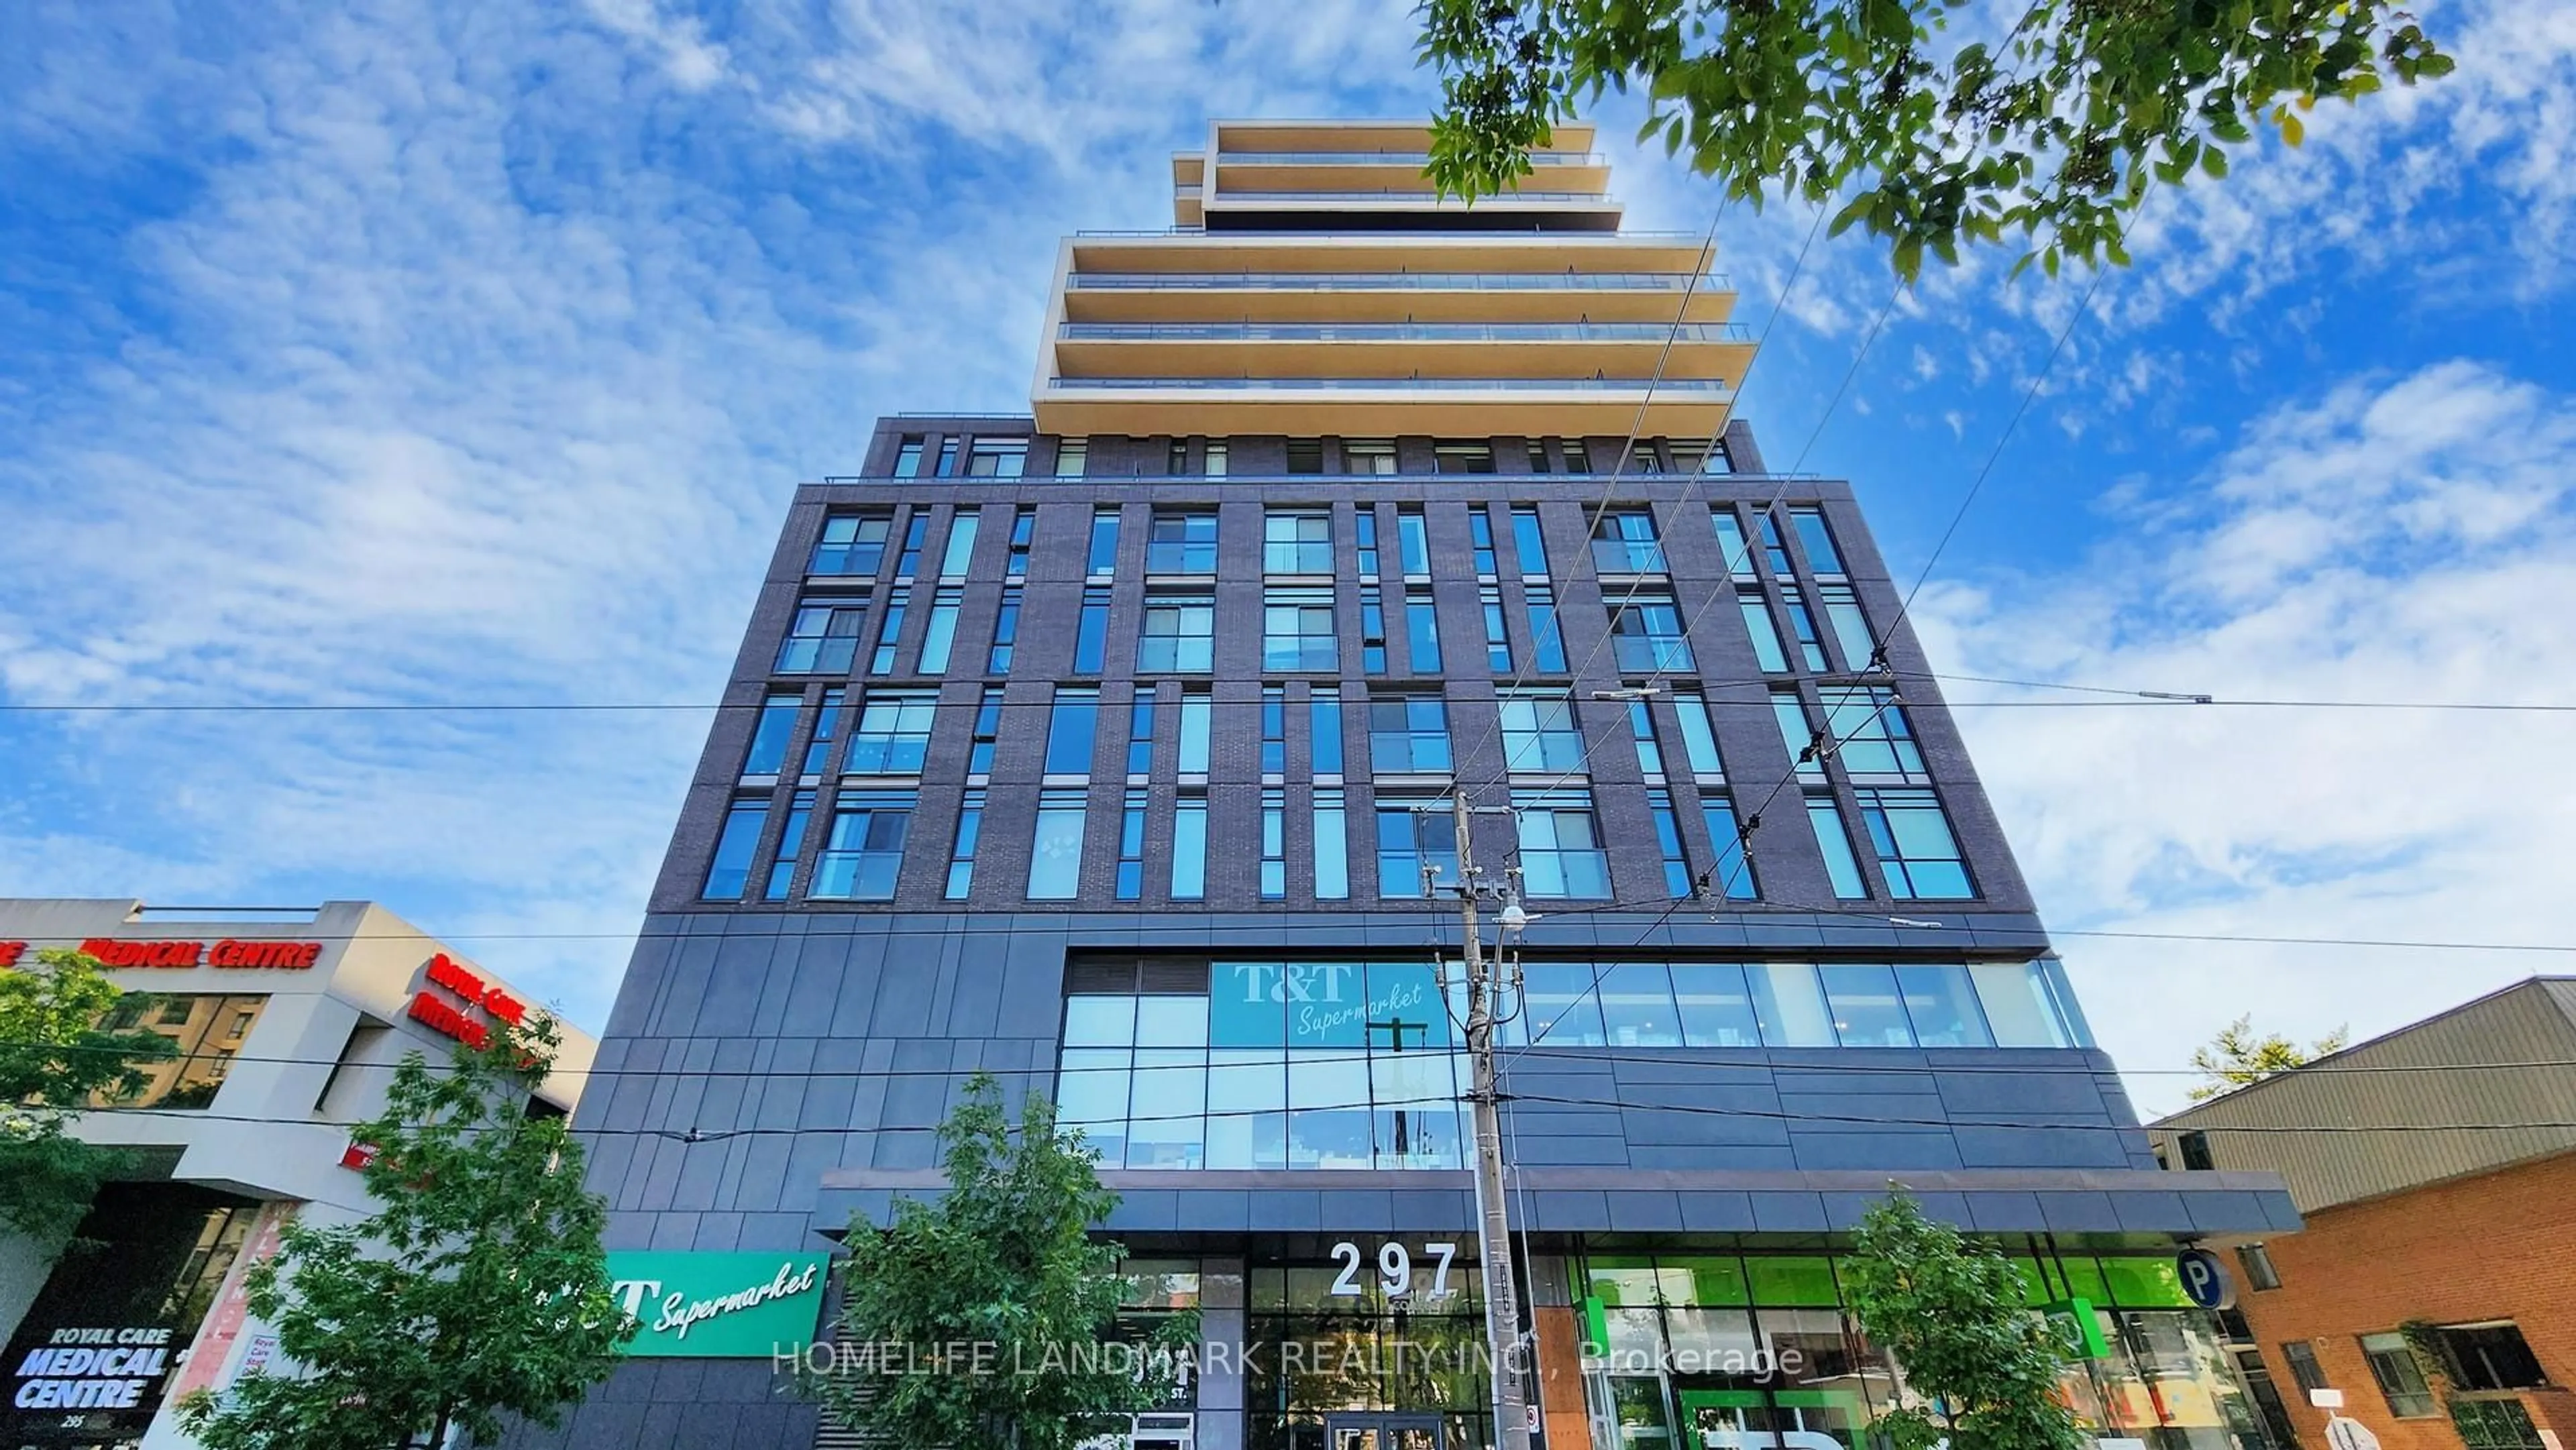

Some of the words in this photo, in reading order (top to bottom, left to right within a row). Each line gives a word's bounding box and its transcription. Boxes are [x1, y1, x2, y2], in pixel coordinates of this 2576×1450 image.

[208, 939, 322, 968] CENTRE
[1234, 966, 1351, 1003] T&T
[407, 991, 495, 1051] MEDICA
[1297, 983, 1422, 1041] Supermarket
[1331, 1242, 1455, 1295] 297
[2185, 1260, 2209, 1300] P
[653, 1262, 816, 1340] Supermarket
[50, 1329, 114, 1344] ROYAL
[117, 1329, 173, 1344] CARE
[15, 1347, 168, 1377] MEDICAL
[14, 1378, 148, 1408] CENTRE
